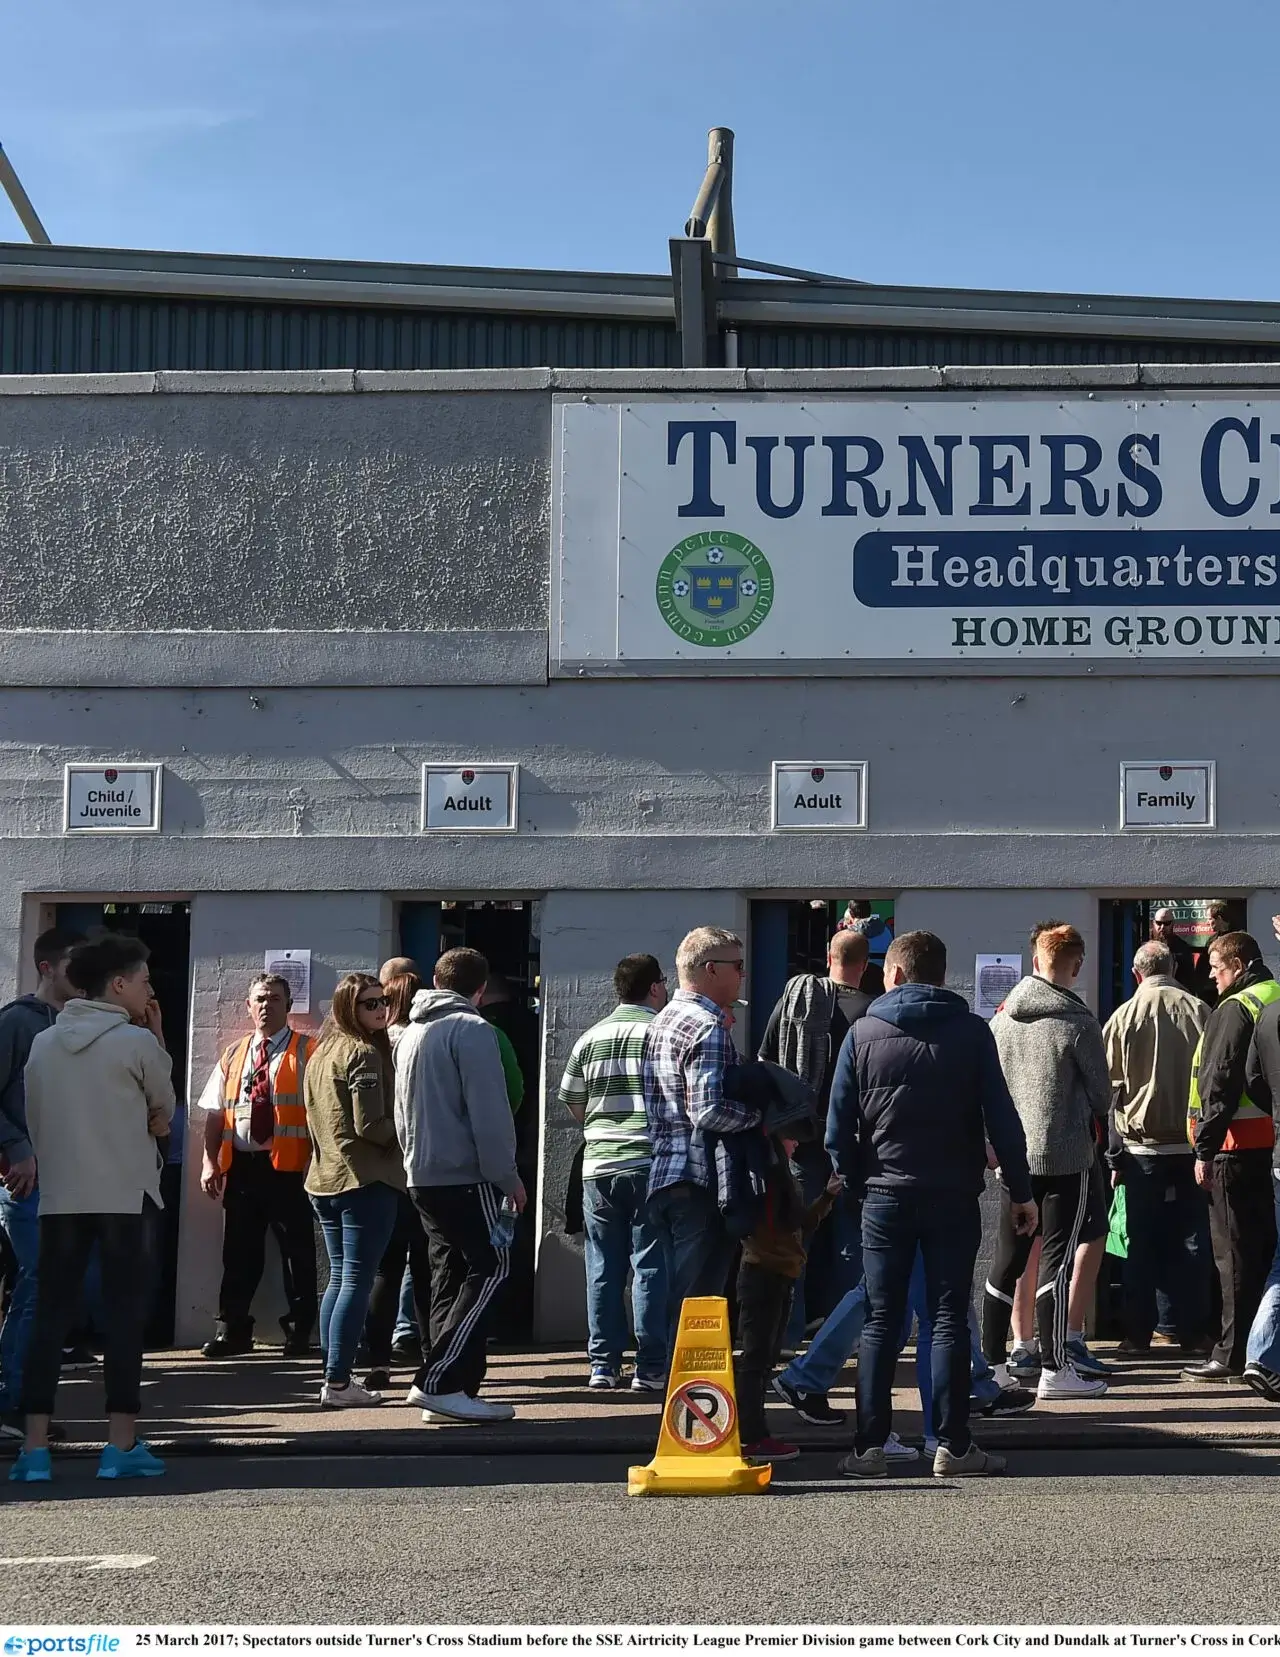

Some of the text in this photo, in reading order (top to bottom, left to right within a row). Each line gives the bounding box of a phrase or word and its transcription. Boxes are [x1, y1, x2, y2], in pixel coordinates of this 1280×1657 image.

[667, 420, 1162, 519] TURNERS
[891, 544, 1278, 593] Headquarters
[951, 616, 1092, 647] HOME
[87, 790, 125, 803] Child
[443, 795, 493, 811] Adult
[793, 793, 842, 809] Adult
[1137, 791, 1196, 810] Family
[80, 805, 142, 818] Juvenile
